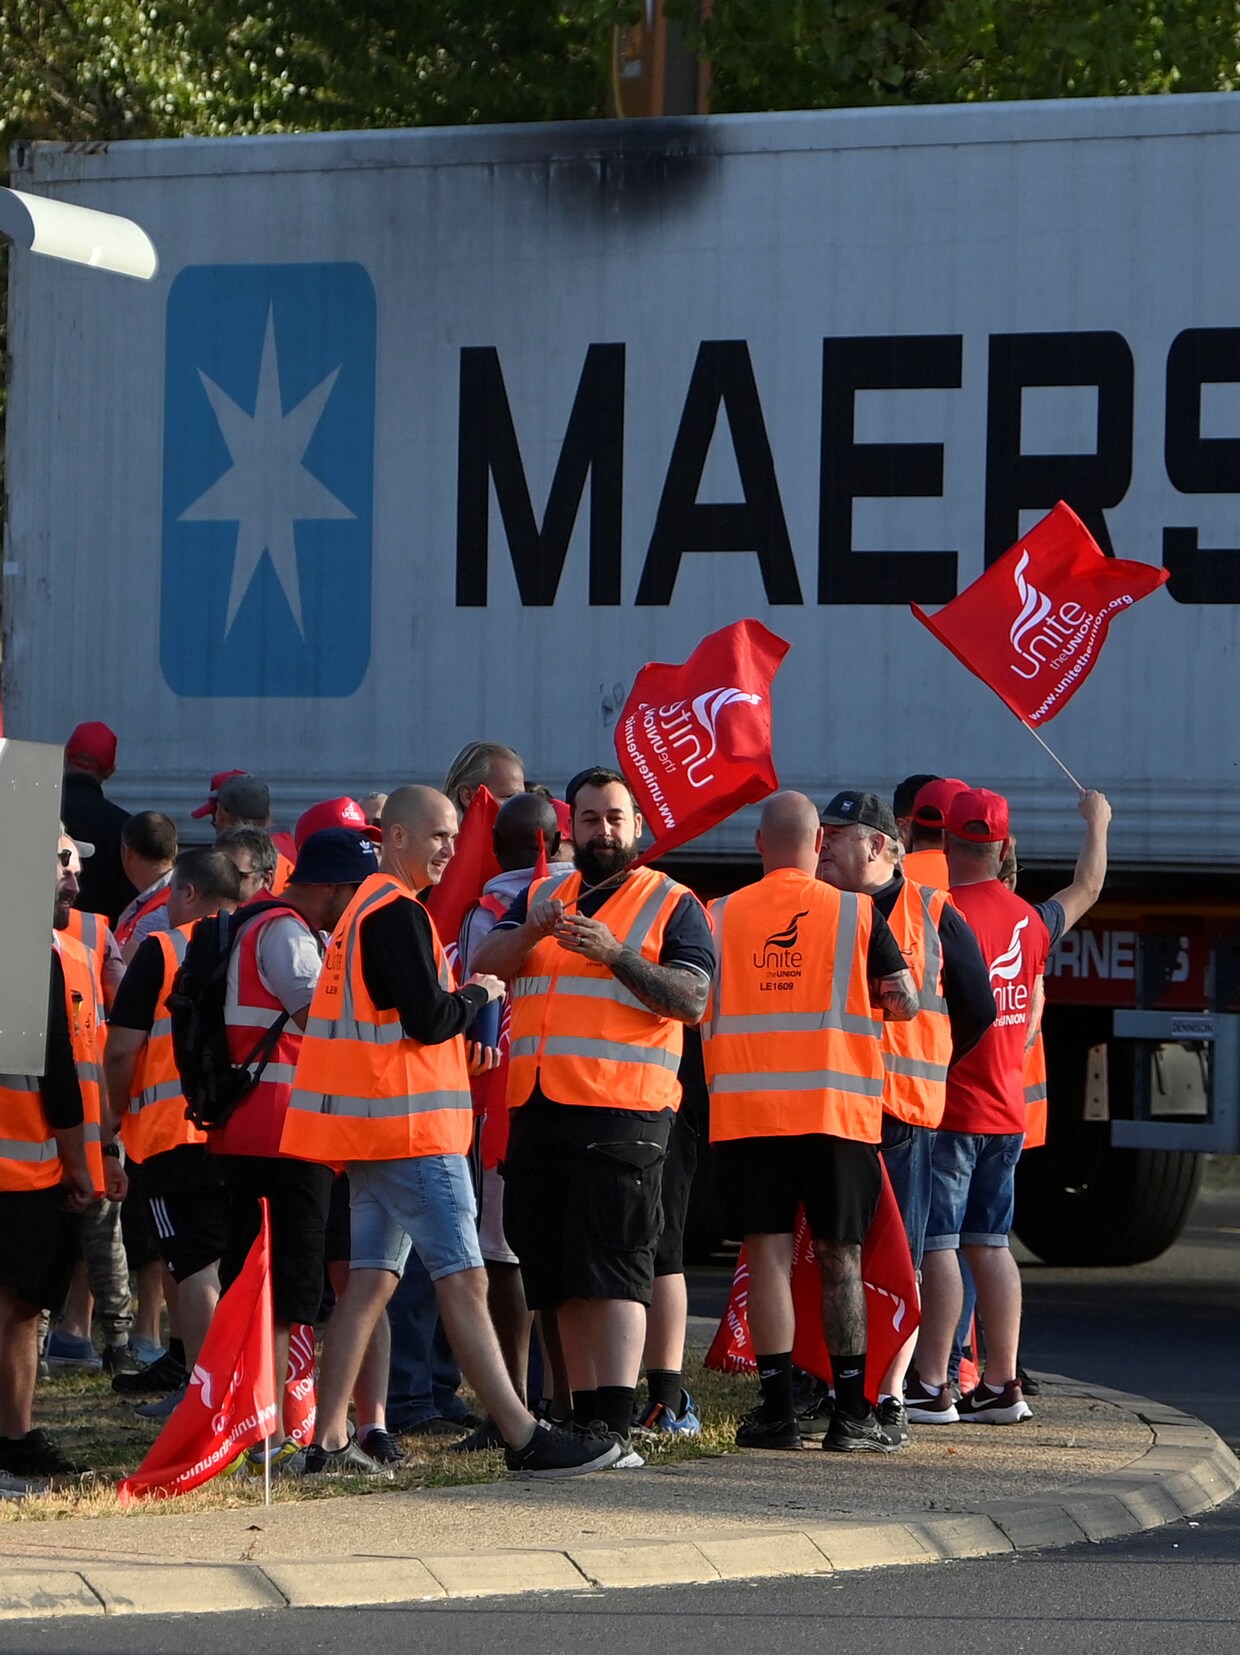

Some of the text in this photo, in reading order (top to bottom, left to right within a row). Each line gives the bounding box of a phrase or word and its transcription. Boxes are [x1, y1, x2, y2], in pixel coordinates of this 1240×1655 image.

[1010, 600, 1087, 680] unite
[1029, 594, 1134, 722] www.unitetheunion.org
[753, 949, 803, 968] unite
[759, 982, 794, 991] LE1609
[993, 981, 1028, 1011] nite
